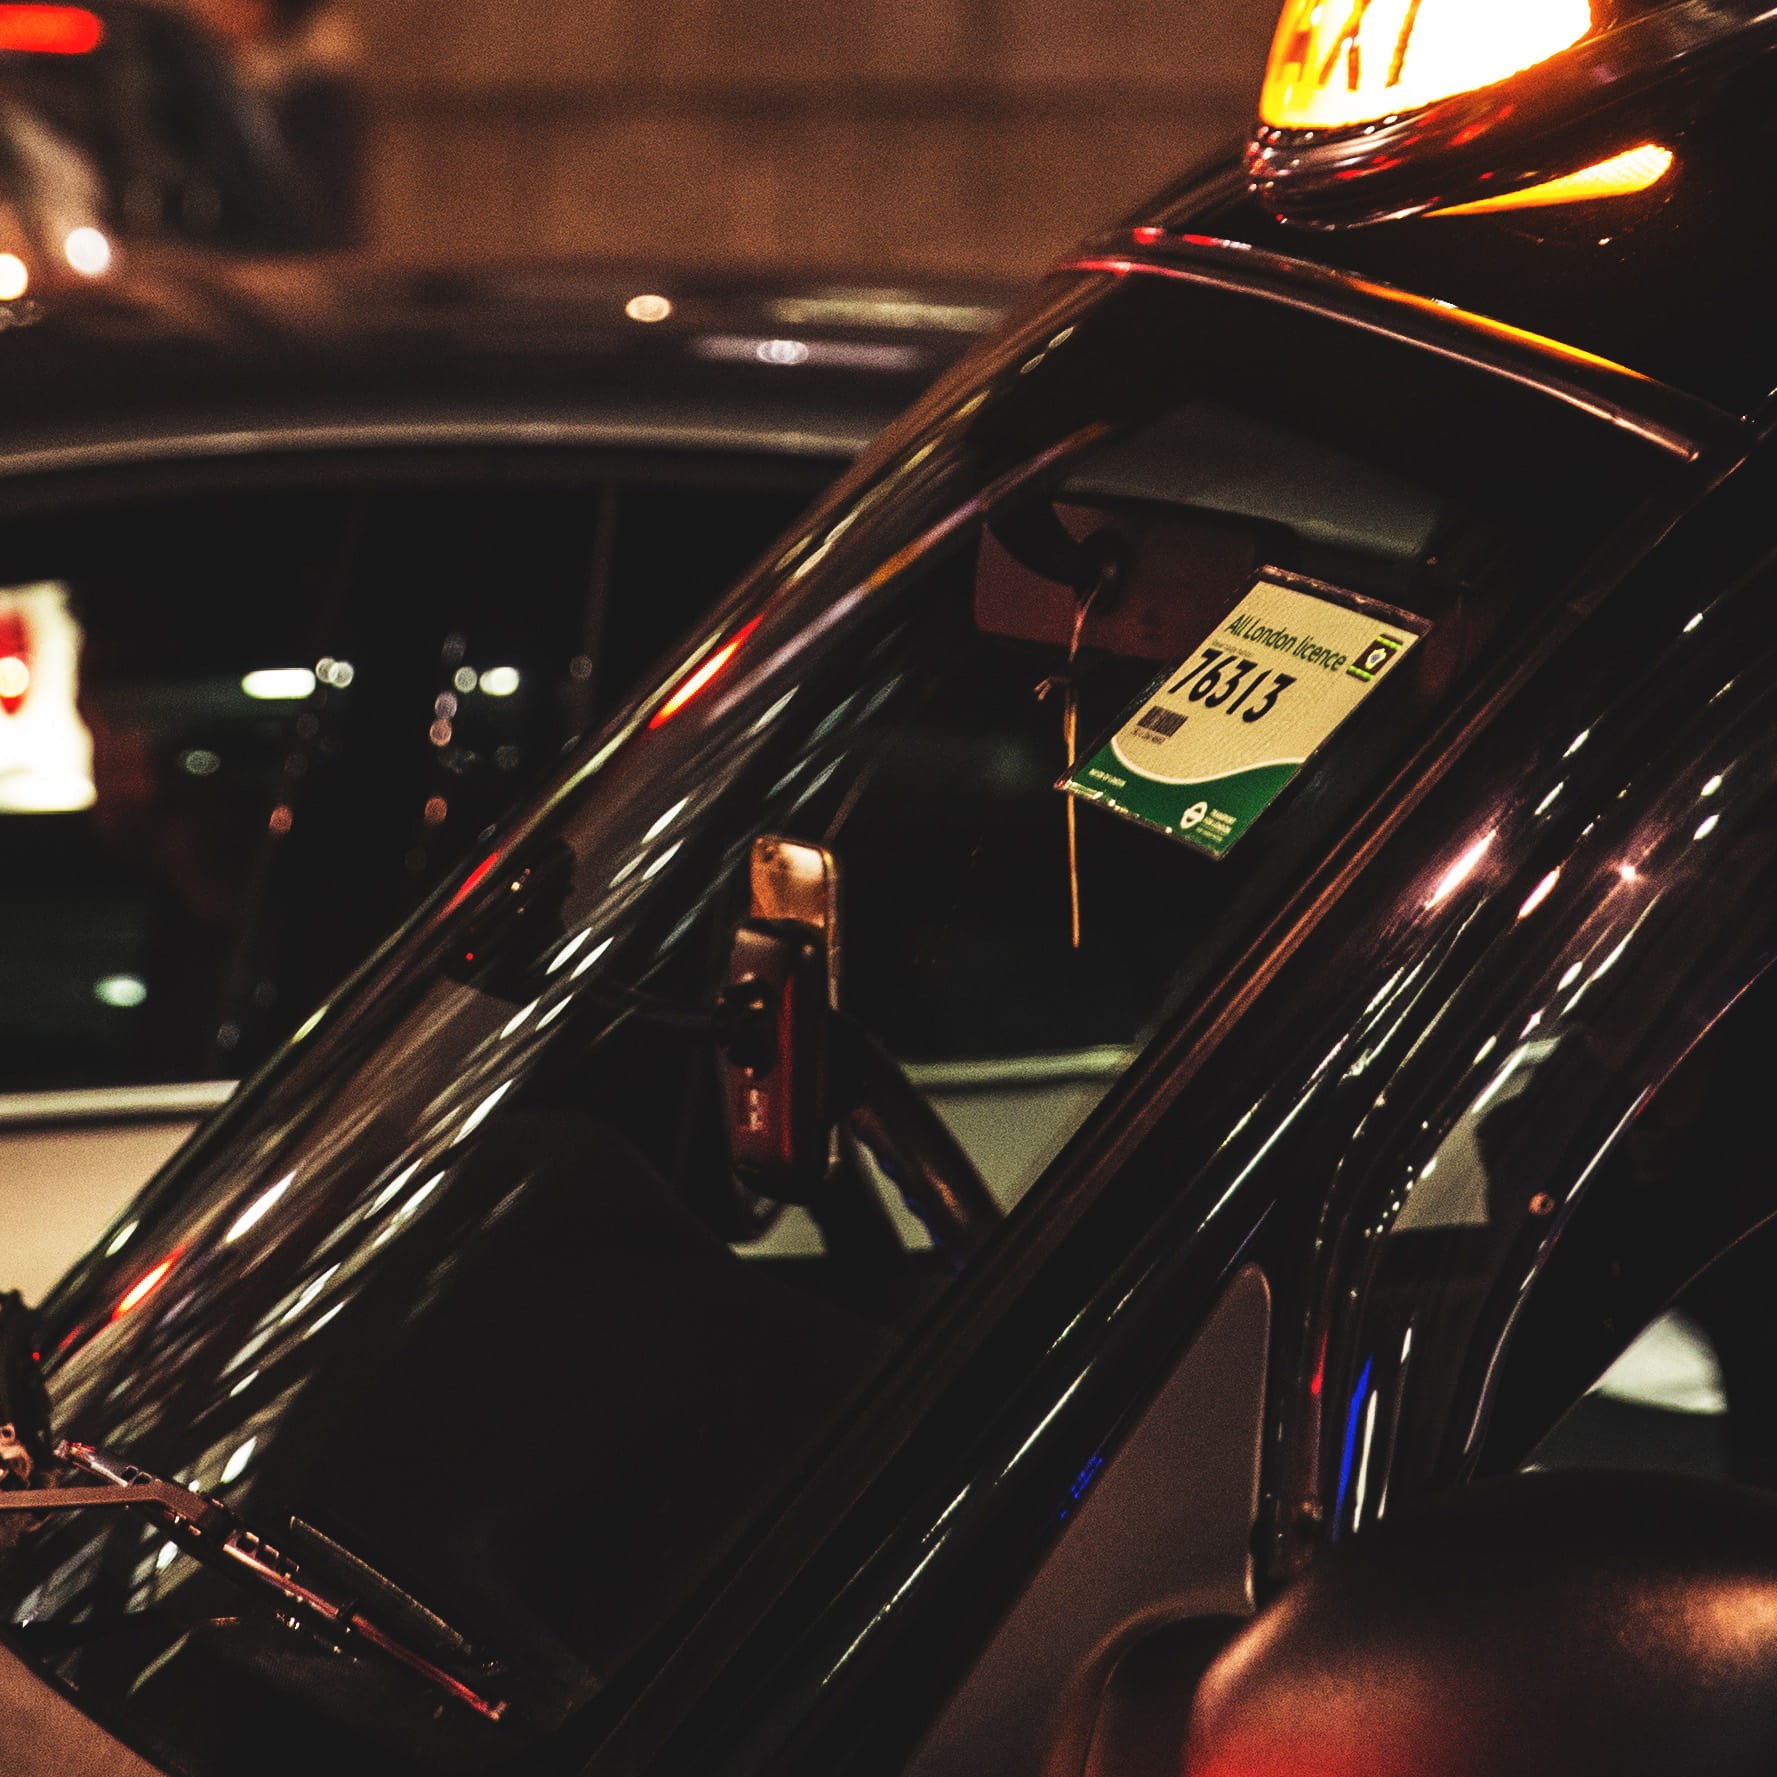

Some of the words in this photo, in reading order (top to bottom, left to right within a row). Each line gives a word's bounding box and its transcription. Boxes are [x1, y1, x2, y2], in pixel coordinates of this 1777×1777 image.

[1223, 614, 1250, 638] All
[1243, 618, 1298, 654] London
[1295, 635, 1347, 672] licence
[1167, 647, 1298, 723] 76313
